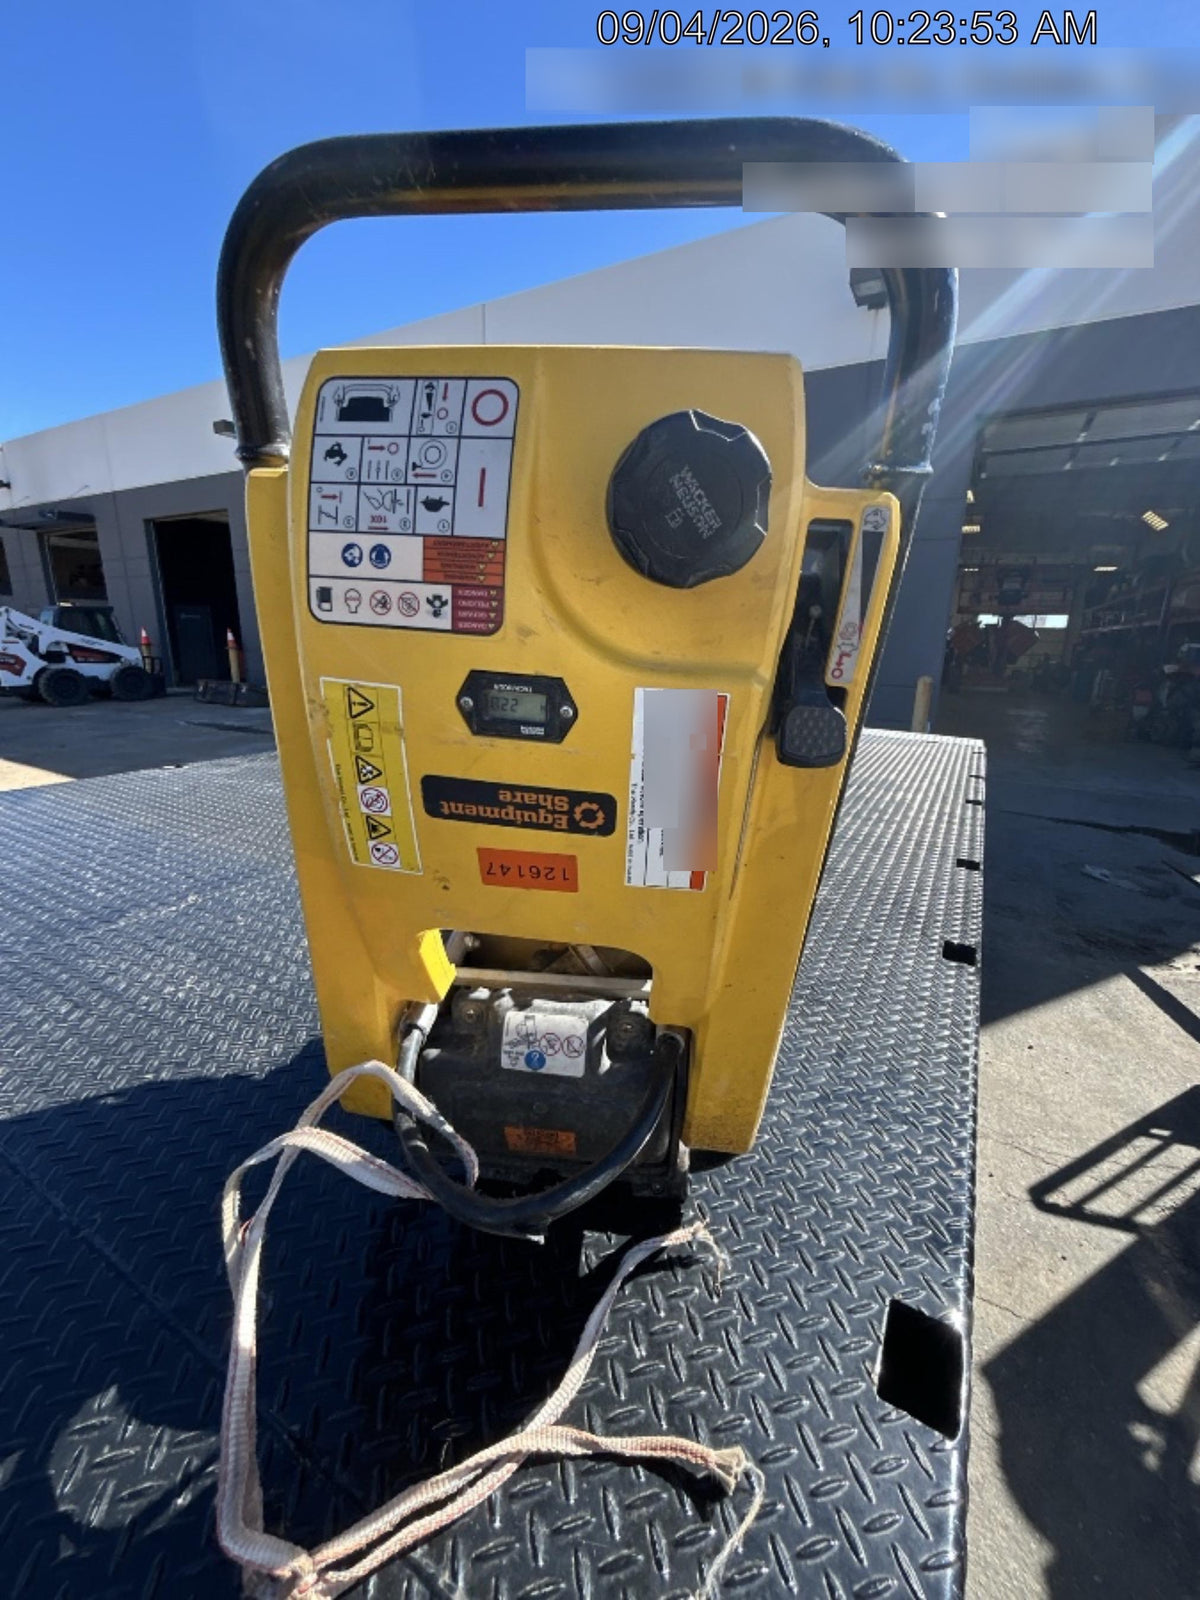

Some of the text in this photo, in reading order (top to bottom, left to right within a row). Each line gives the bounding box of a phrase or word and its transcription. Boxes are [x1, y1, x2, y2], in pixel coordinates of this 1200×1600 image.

[499, 790, 569, 812] Share
[439, 801, 569, 830] Equipment
[486, 862, 571, 881] 126147
